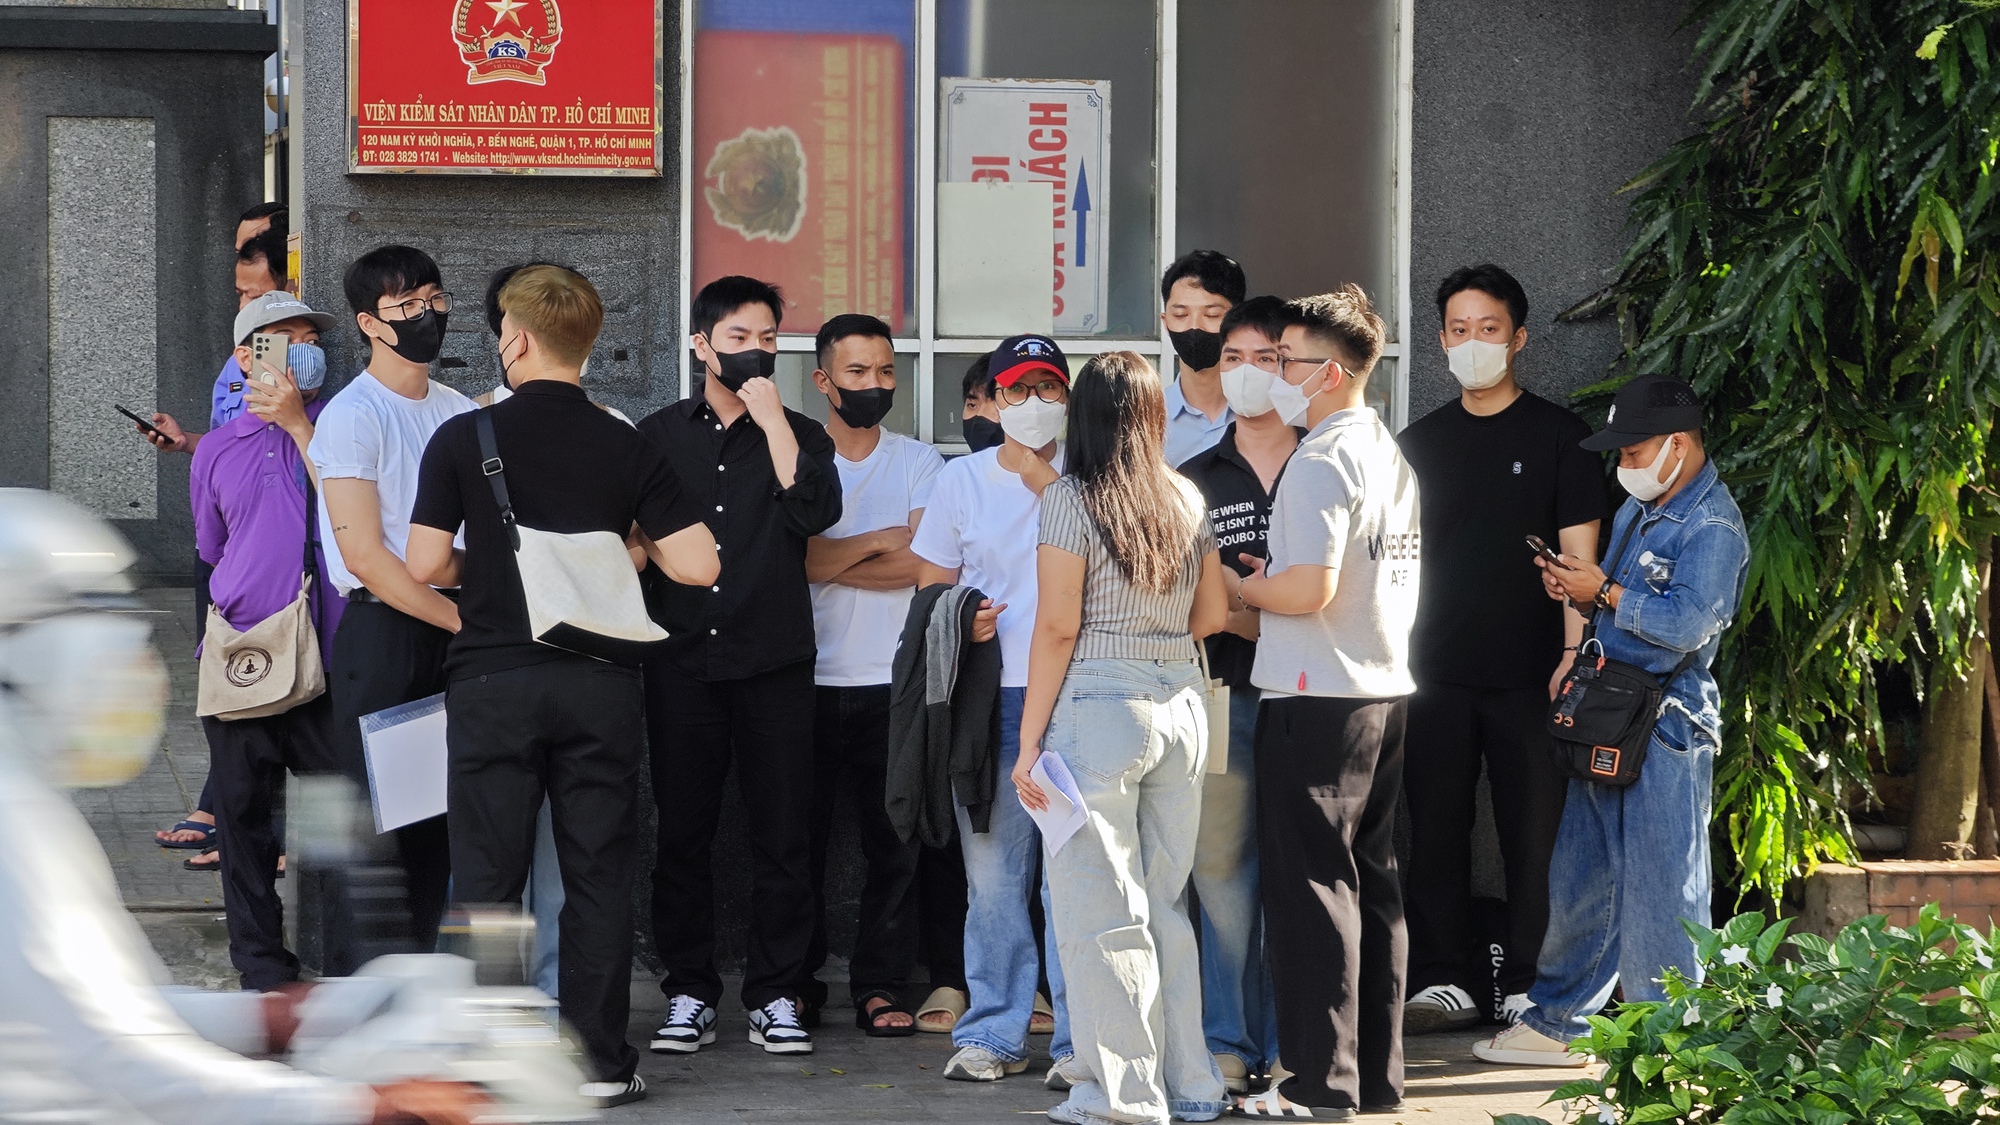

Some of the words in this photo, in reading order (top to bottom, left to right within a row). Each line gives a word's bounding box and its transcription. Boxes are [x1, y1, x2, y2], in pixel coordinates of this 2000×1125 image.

[497, 47, 517, 57] KS
[364, 98, 396, 126] VIỆN
[400, 94, 435, 121] KIỂM
[439, 100, 465, 122] SÁT
[469, 100, 505, 123] NHÂN
[509, 101, 537, 123] DÂN
[541, 106, 561, 124] TP.
[565, 96, 584, 124] HỒ
[588, 101, 612, 125] CHÍ
[615, 107, 650, 125] MINH
[362, 134, 378, 146] 120
[380, 134, 401, 146] NAM
[403, 132, 416, 147] KỲ
[418, 132, 441, 147] KHỞI
[443, 133, 475, 149] NGHĨA,
[477, 136, 486, 147] P.
[488, 132, 508, 148] BẾN
[510, 133, 538, 149] NGHÉ,
[540, 134, 566, 151] QUẬN
[568, 138, 577, 150] 1,
[578, 137, 593, 149] TP.
[595, 133, 608, 149] HỒ
[610, 134, 626, 149] CHÍ
[628, 138, 652, 149] MINH
[363, 150, 378, 162] ĐT:
[379, 150, 395, 162] 028
[397, 151, 418, 163] 3829
[420, 152, 440, 163] 1741
[452, 152, 488, 164] Website:
[1220, 501, 1255, 517] WHEN
[1226, 516, 1256, 530] ISN'T
[1259, 515, 1267, 525] A
